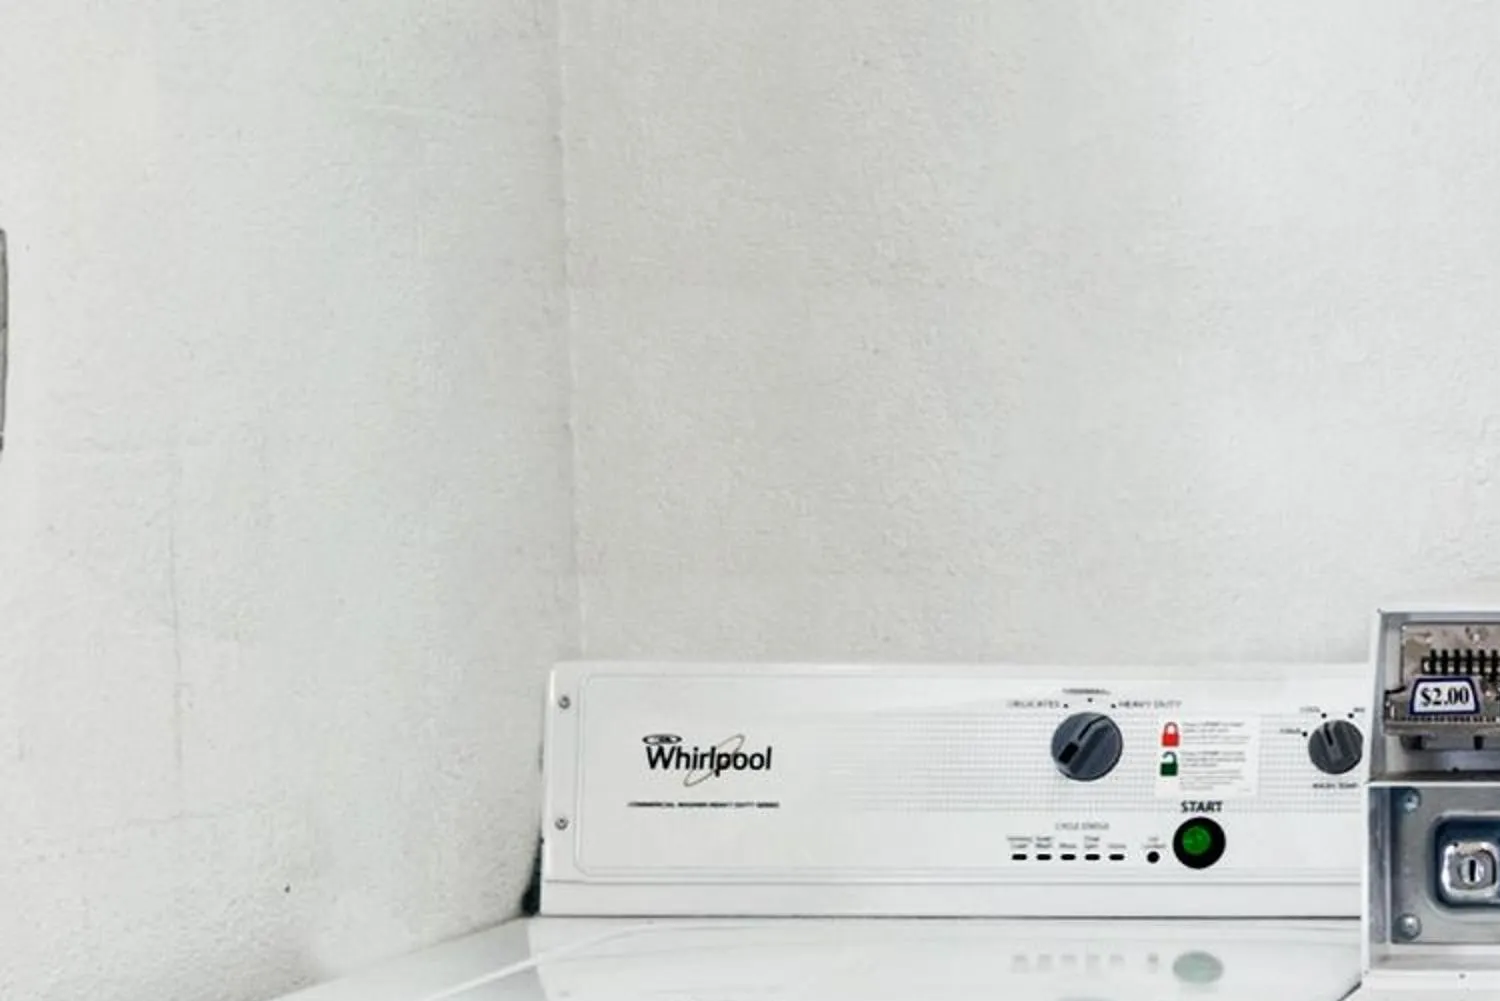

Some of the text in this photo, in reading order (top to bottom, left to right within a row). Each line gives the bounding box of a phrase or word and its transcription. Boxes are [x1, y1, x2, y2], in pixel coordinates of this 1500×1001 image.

[1421, 687, 1469, 707] $2.00
[645, 745, 772, 778] Whirlpool
[1181, 799, 1223, 813] START
